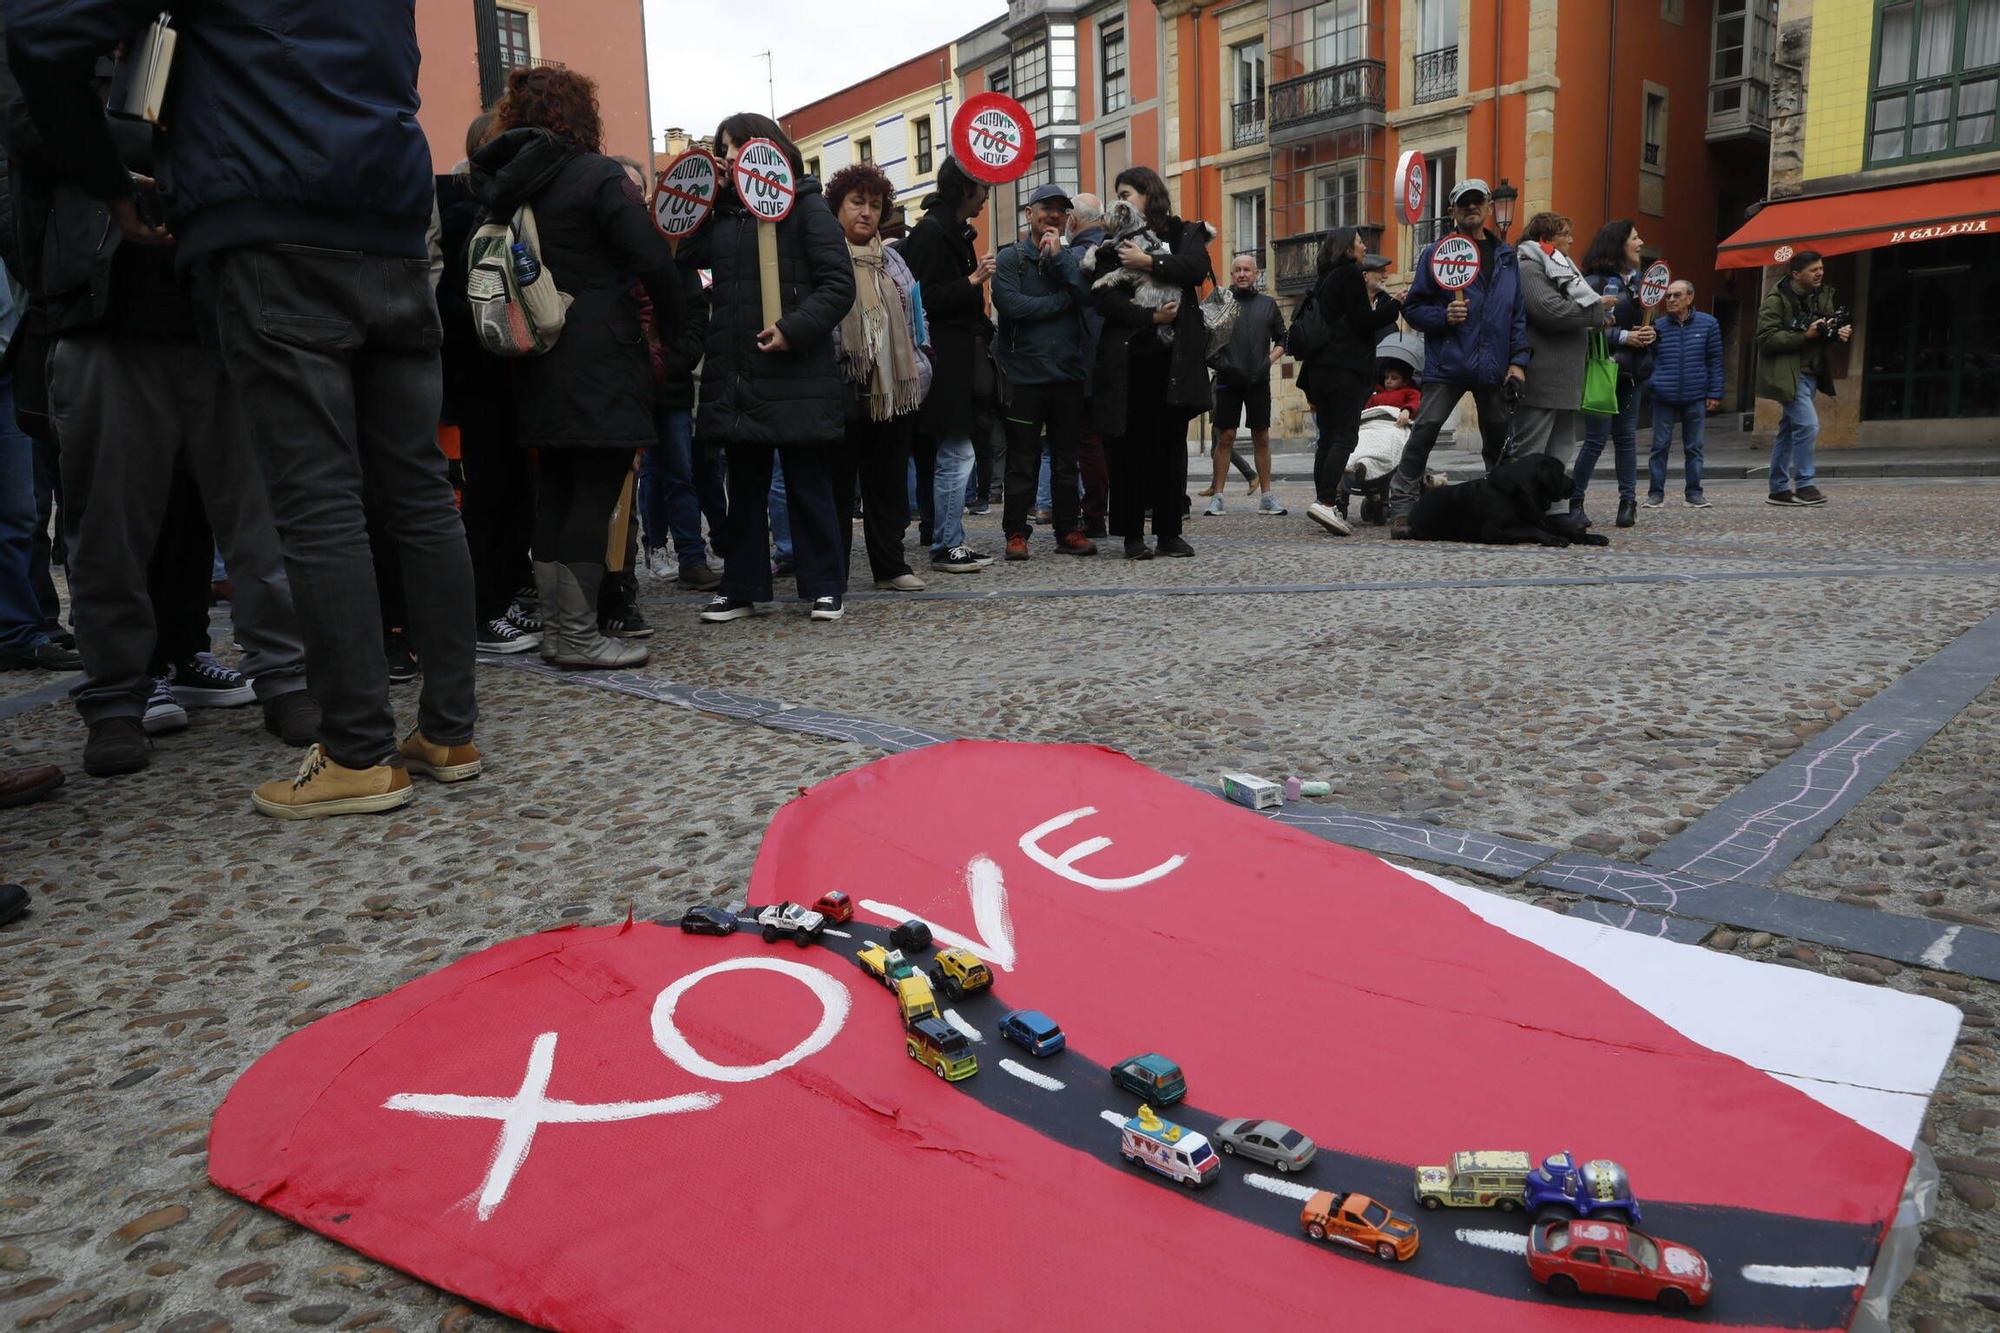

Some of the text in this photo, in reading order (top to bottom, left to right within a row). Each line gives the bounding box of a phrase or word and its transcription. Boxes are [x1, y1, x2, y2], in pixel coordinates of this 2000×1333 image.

[979, 152, 1009, 164] JOVE
[753, 200, 784, 215] JOVE
[662, 216, 697, 232] JOVE
[1909, 220, 1989, 240] GALANA
[1444, 273, 1470, 286] JOVE
